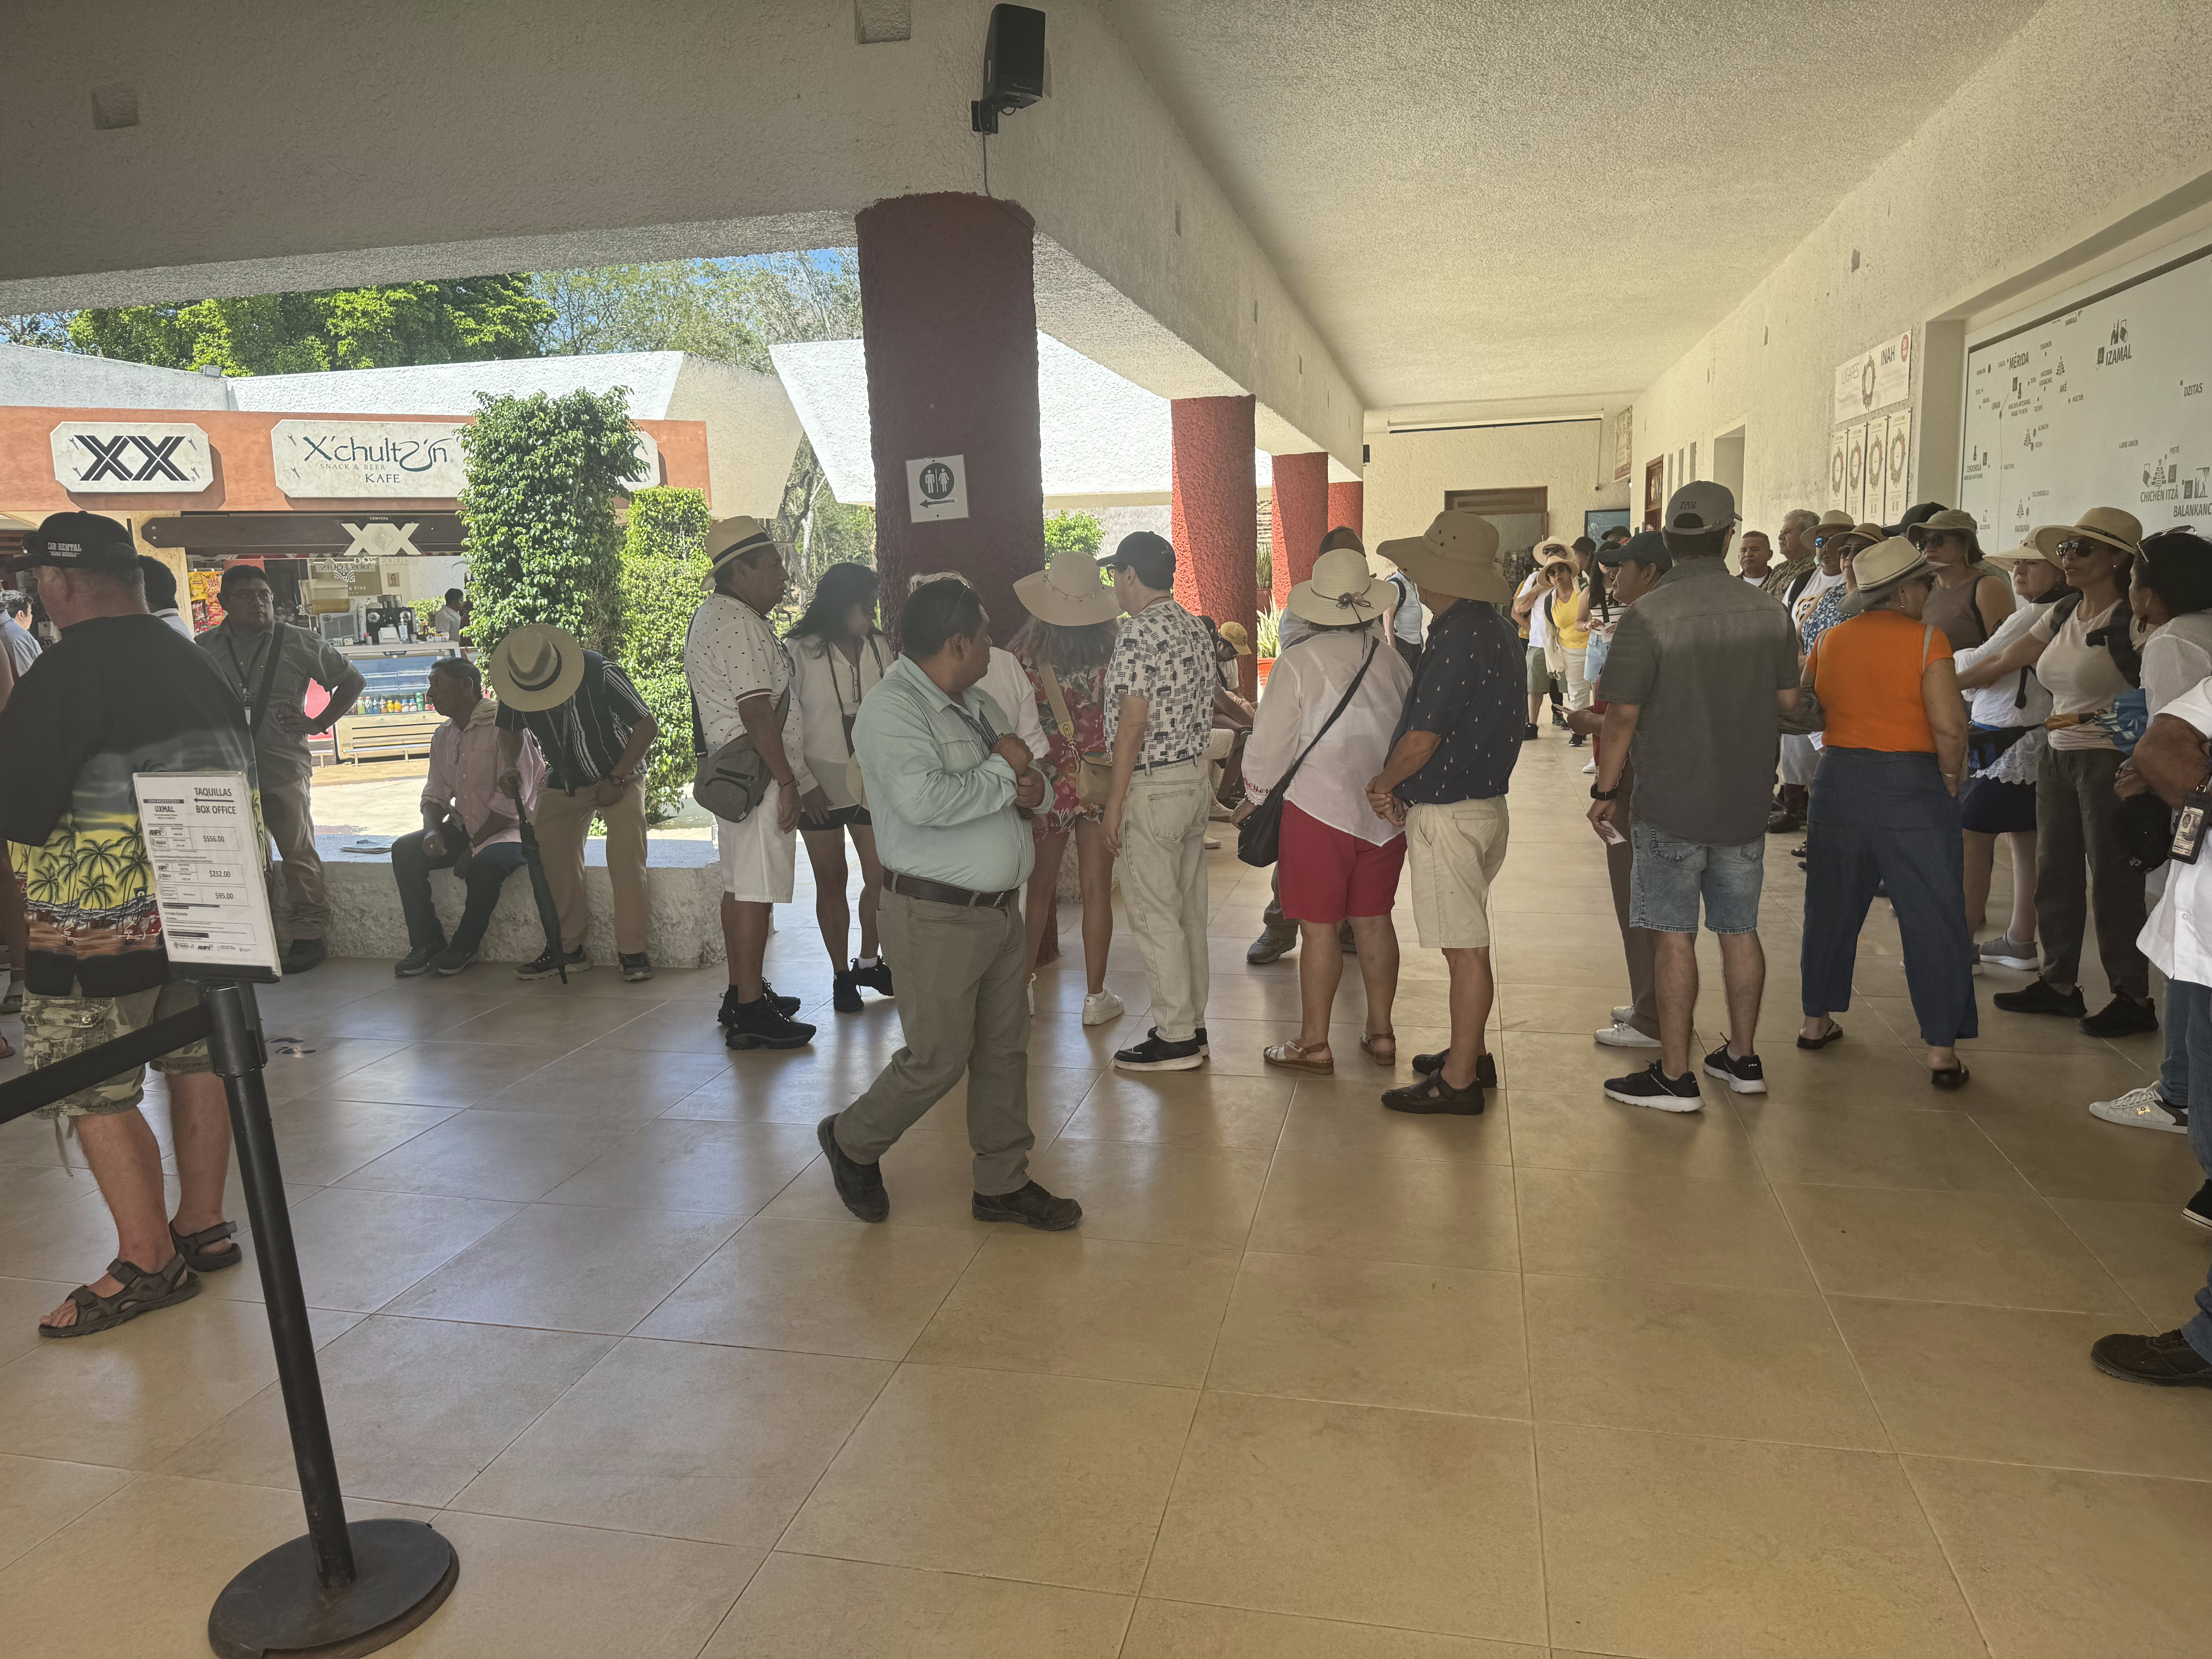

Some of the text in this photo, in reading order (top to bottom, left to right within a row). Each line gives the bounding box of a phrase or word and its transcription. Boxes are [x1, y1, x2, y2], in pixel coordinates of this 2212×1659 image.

[1881, 345, 1895, 366] INAH
[2009, 352, 2029, 370] MÉRIDA
[2106, 344, 2131, 366] IZAMAL
[1841, 363, 1858, 385] LUGARES
[2184, 383, 2202, 397] DZITAS
[2169, 444, 2179, 454] PISTÉ
[74, 435, 191, 481] XX
[365, 474, 400, 483] KAFE
[2140, 485, 2178, 502] CHICHÉN ITZÁ
[58, 543, 82, 551] RENTAL
[341, 523, 422, 555] XX
[194, 788, 232, 797] TAQUILLAS
[196, 805, 236, 814] BOX OFFICE
